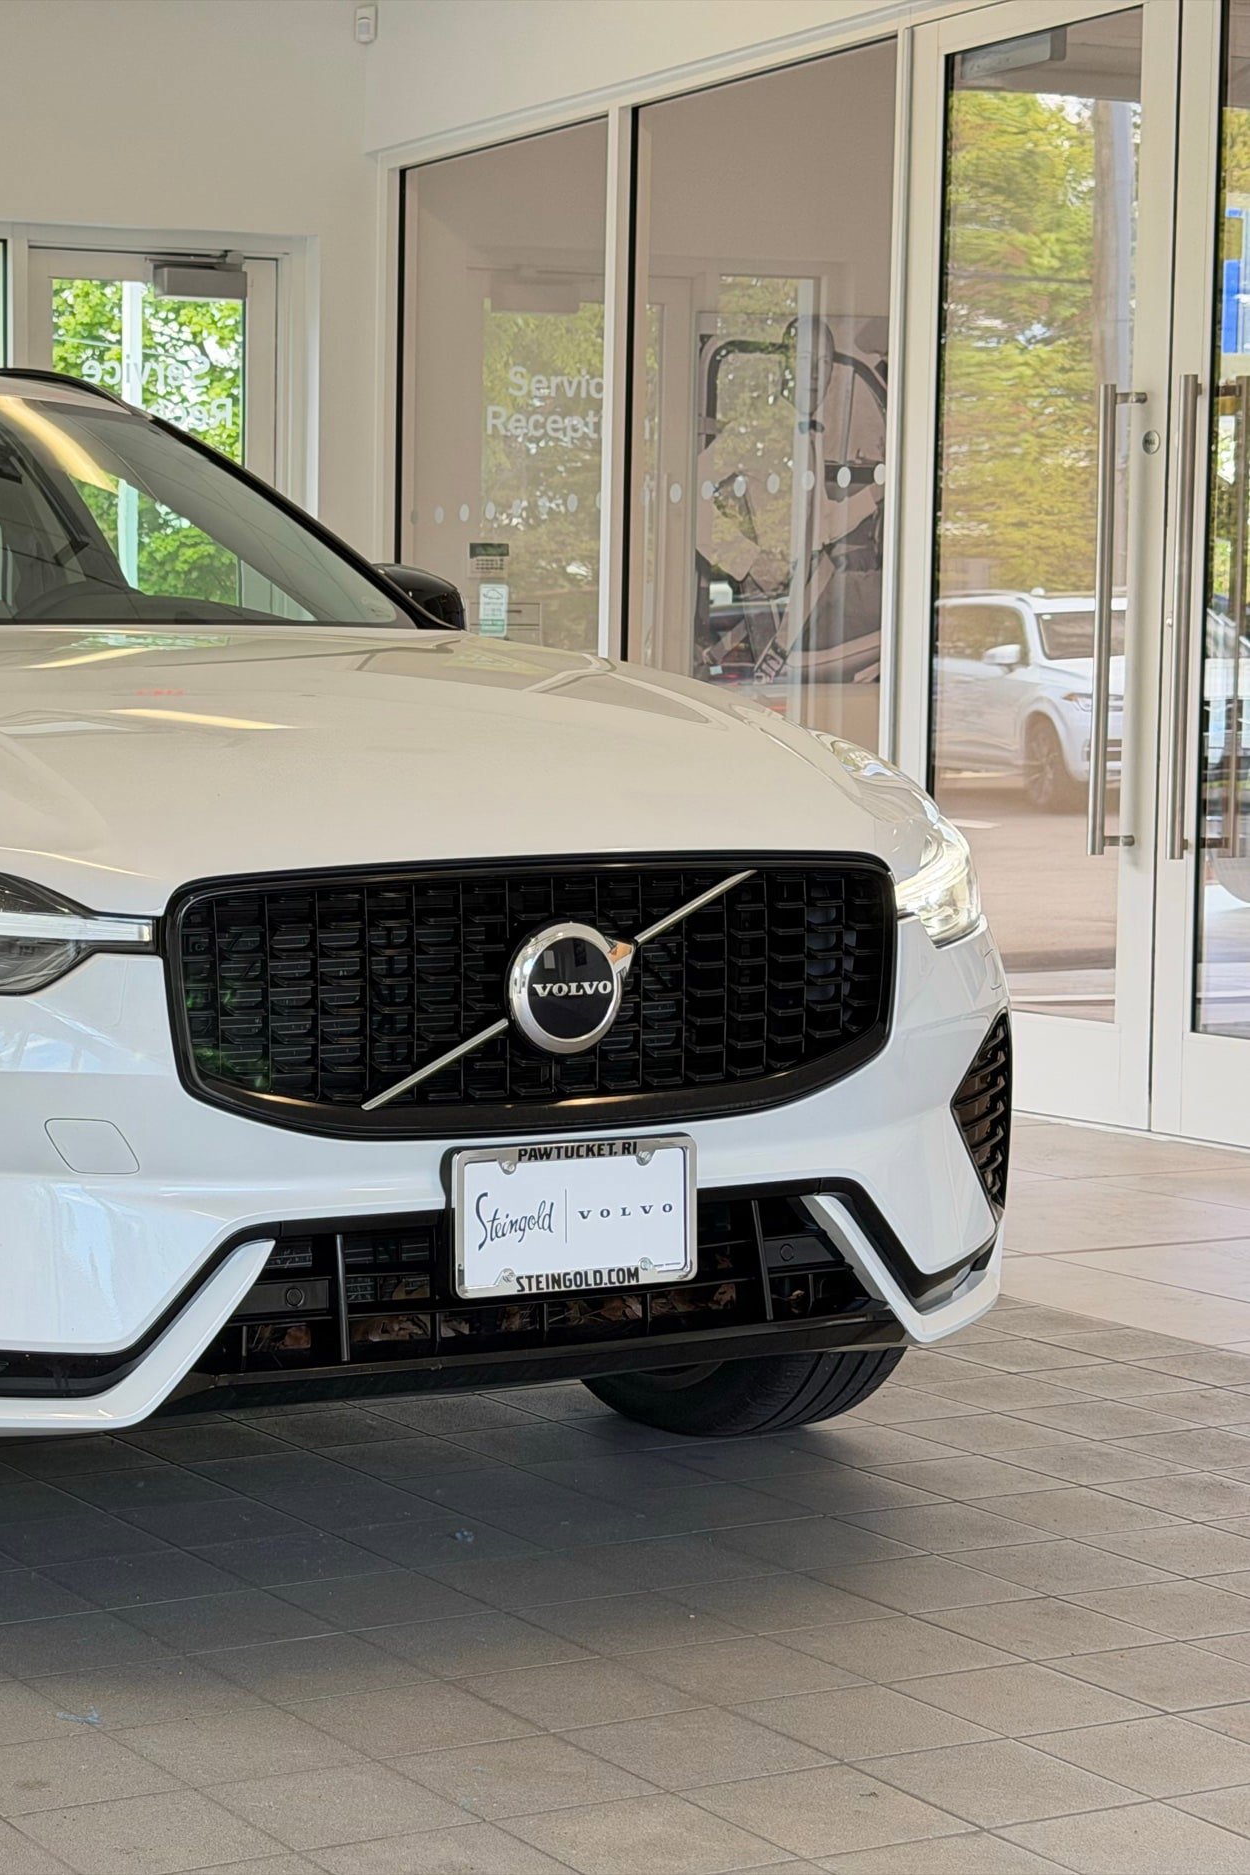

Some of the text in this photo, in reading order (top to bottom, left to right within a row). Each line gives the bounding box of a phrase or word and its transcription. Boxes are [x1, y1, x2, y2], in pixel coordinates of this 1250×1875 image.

[508, 366, 604, 398] Servic
[486, 405, 601, 447] Recept
[532, 980, 612, 998] VOLVO
[621, 1141, 638, 1156] RI
[475, 1191, 674, 1251] Steingold VOLVO
[516, 1266, 639, 1293] STEINGOLD.COM
